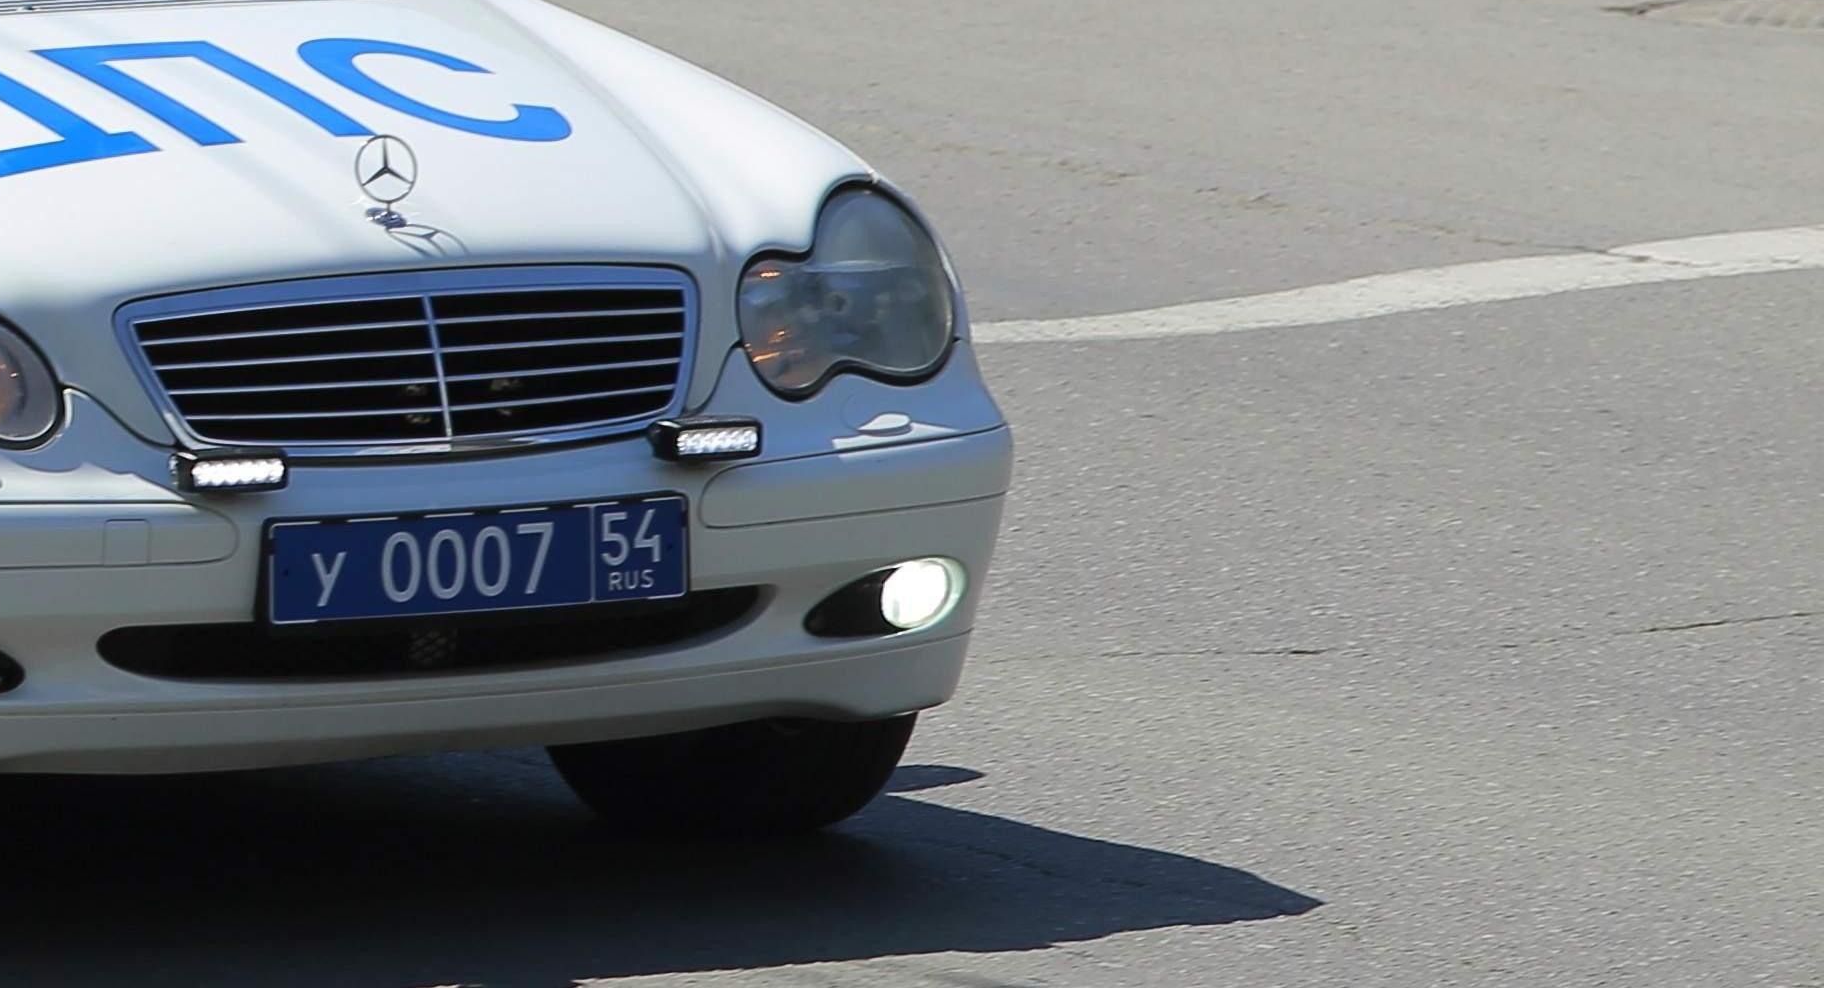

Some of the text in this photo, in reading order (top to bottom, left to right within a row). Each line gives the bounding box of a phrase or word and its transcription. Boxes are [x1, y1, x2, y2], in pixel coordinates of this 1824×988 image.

[380, 521, 555, 604] 0007
[600, 508, 662, 567] 54
[608, 569, 655, 592] RUS
